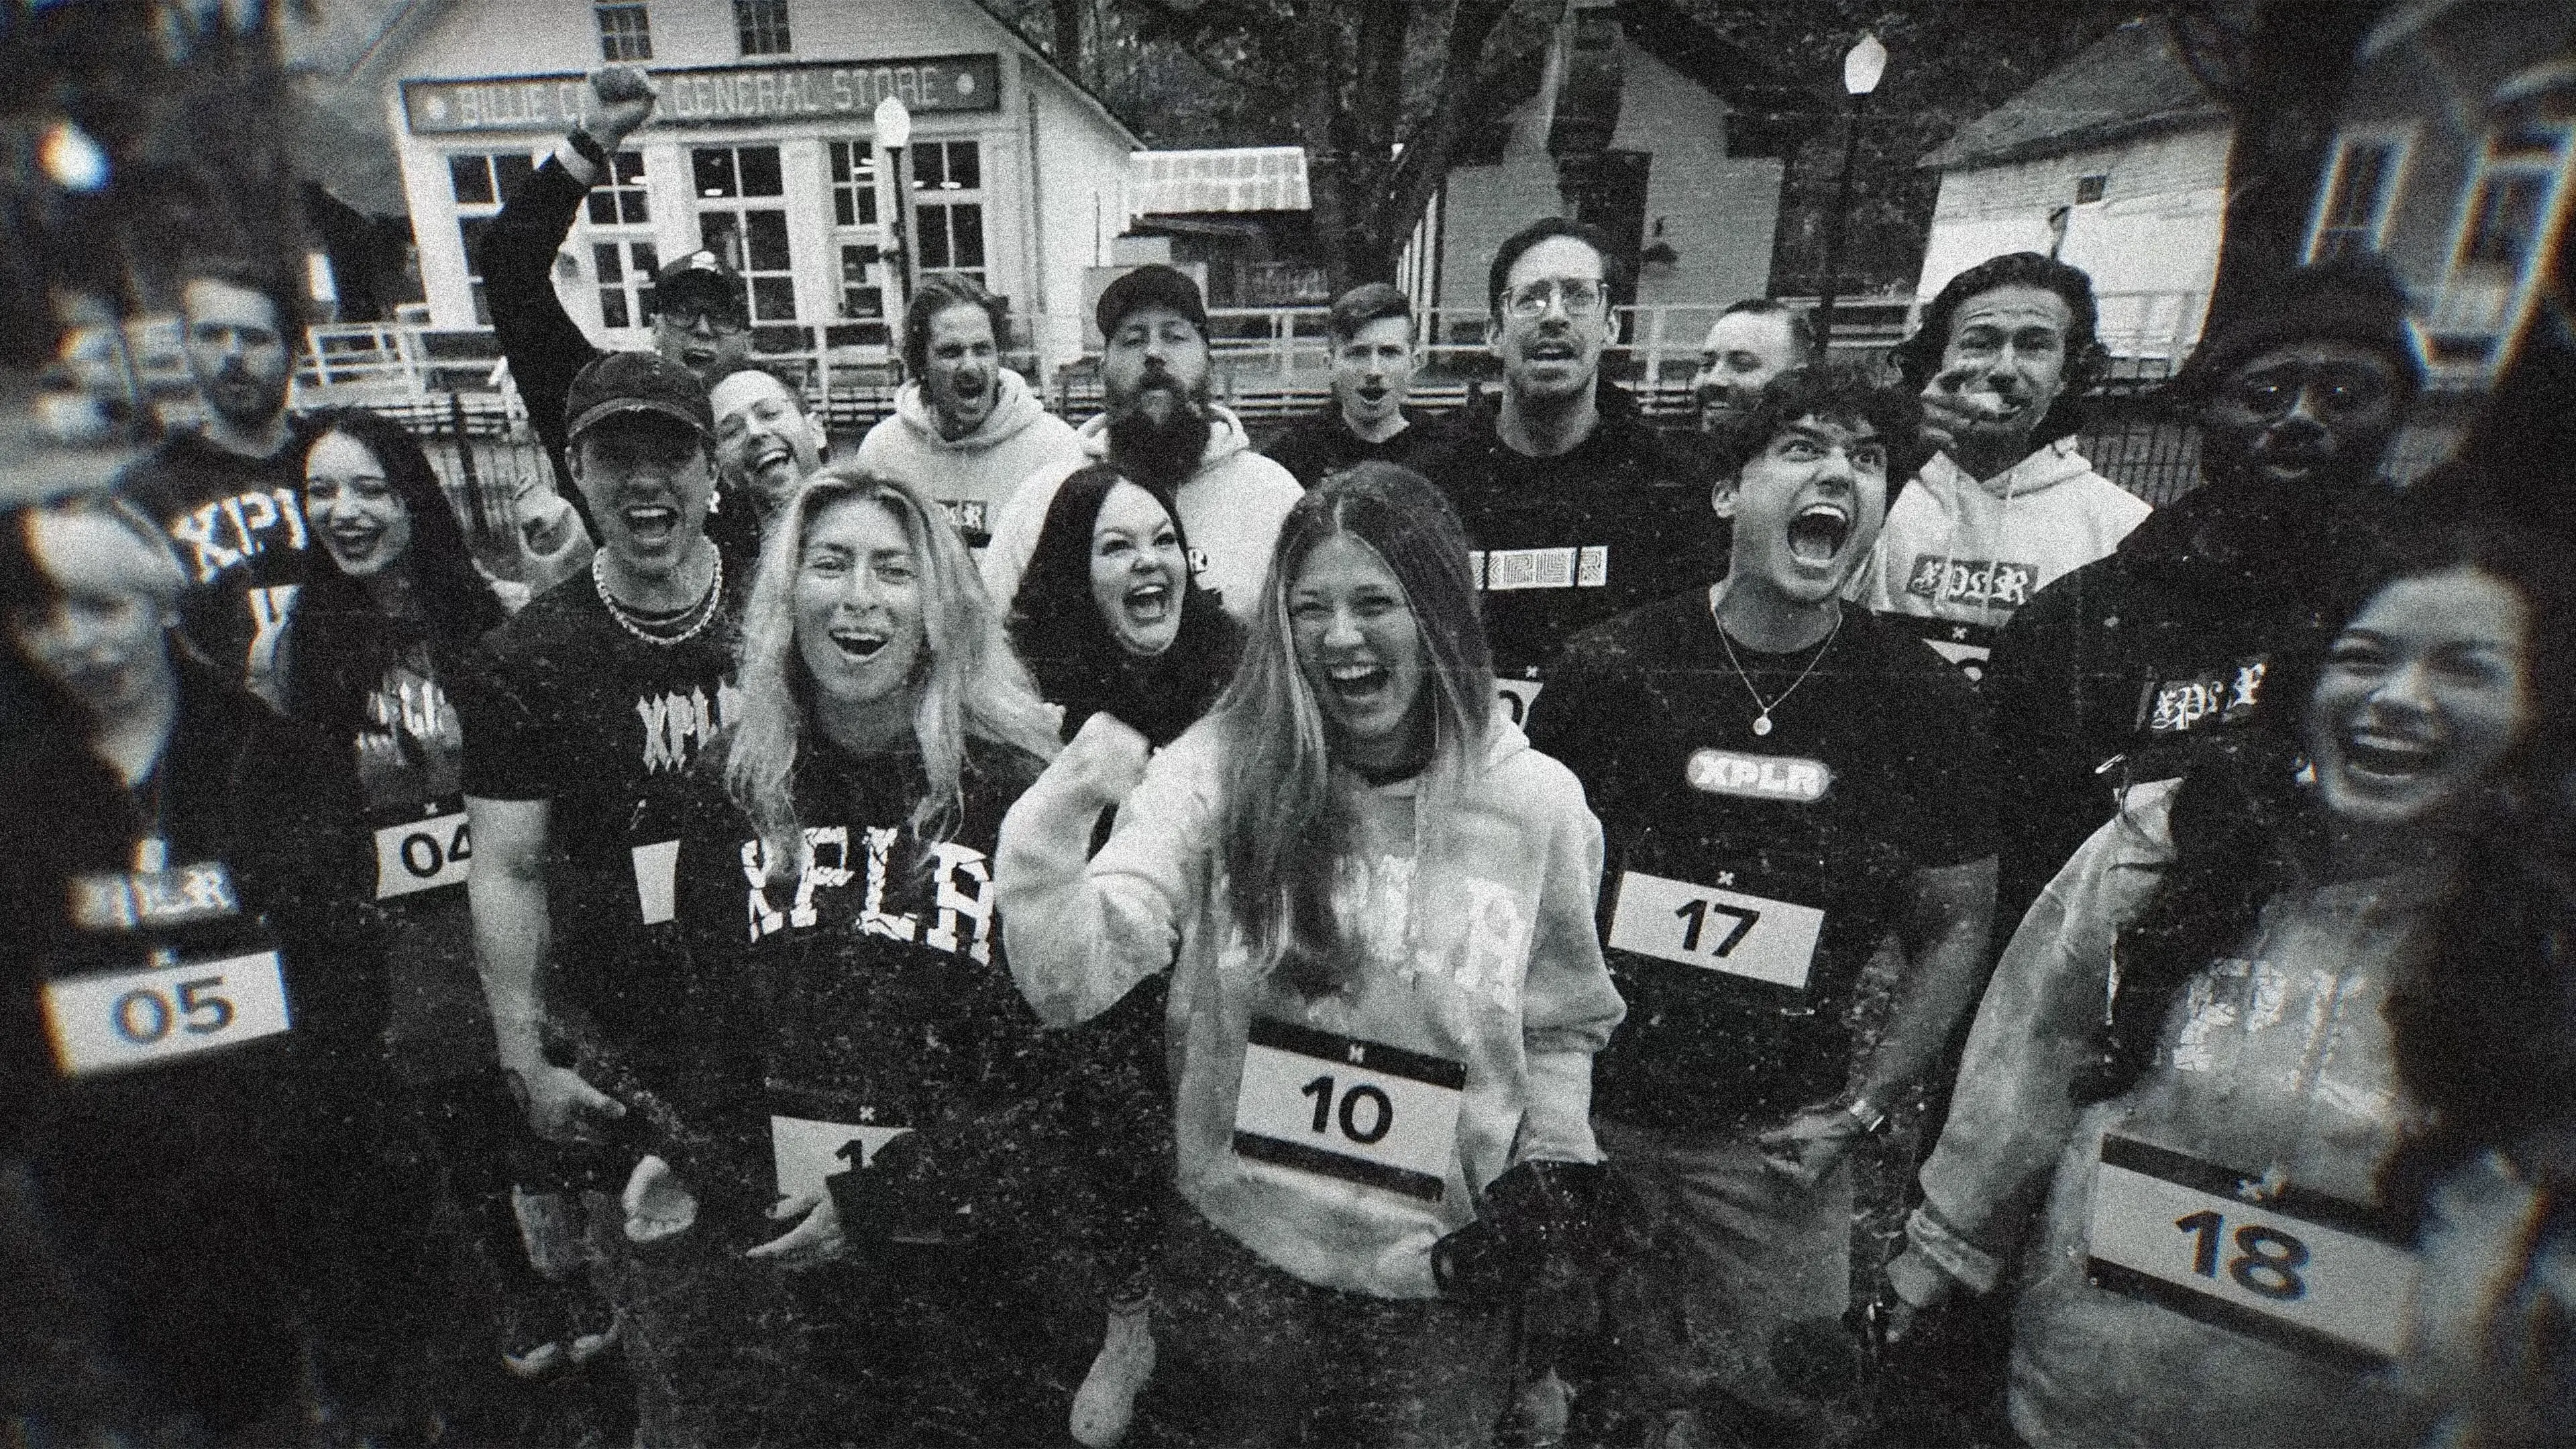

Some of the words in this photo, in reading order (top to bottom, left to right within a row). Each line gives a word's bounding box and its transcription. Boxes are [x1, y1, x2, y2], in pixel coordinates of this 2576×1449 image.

[456, 85, 547, 123] BILLIE
[674, 72, 820, 116] GENERAL
[831, 66, 939, 111] STORE
[1695, 755, 1820, 797] XPLR
[400, 823, 473, 878] 04
[1675, 898, 1760, 958] 17
[111, 975, 236, 1046] 05
[1301, 1075, 1394, 1144] 10
[2174, 1209, 2311, 1302] 18
